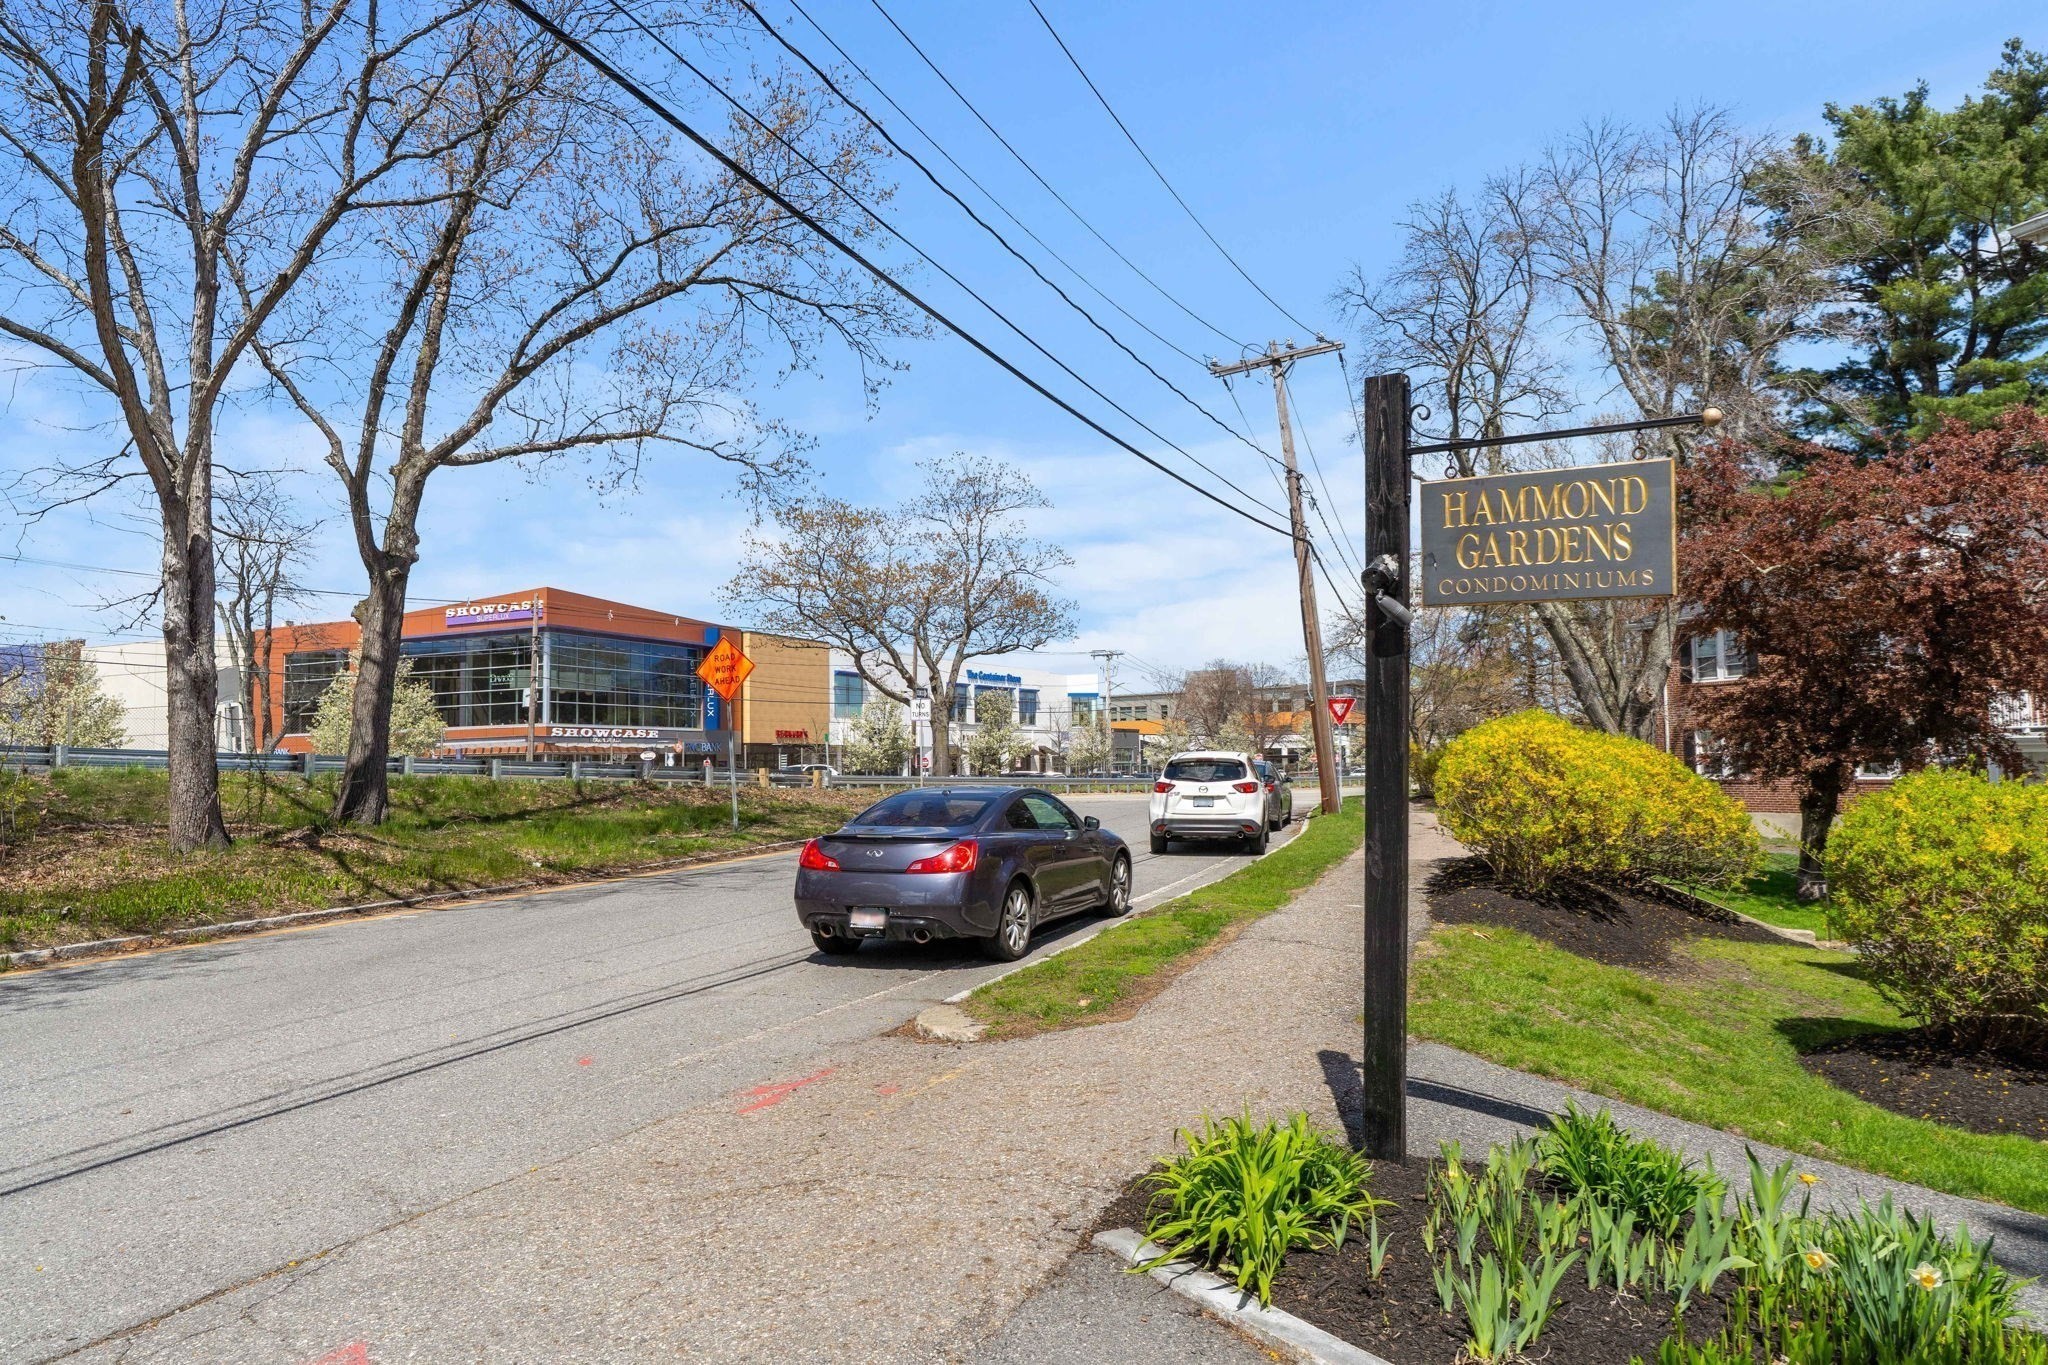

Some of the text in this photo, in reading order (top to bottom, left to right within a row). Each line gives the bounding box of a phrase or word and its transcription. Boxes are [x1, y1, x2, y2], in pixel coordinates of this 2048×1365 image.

[1441, 475, 1649, 529] HAMMOND
[1456, 522, 1633, 570] GARDENS
[1438, 569, 1655, 596] CONDOMINIUMS
[714, 653, 736, 662] ROAD
[714, 664, 737, 674] WORK
[714, 675, 741, 686] AHEAD
[915, 702, 926, 710] NO
[551, 727, 659, 738] SHOWCASE
